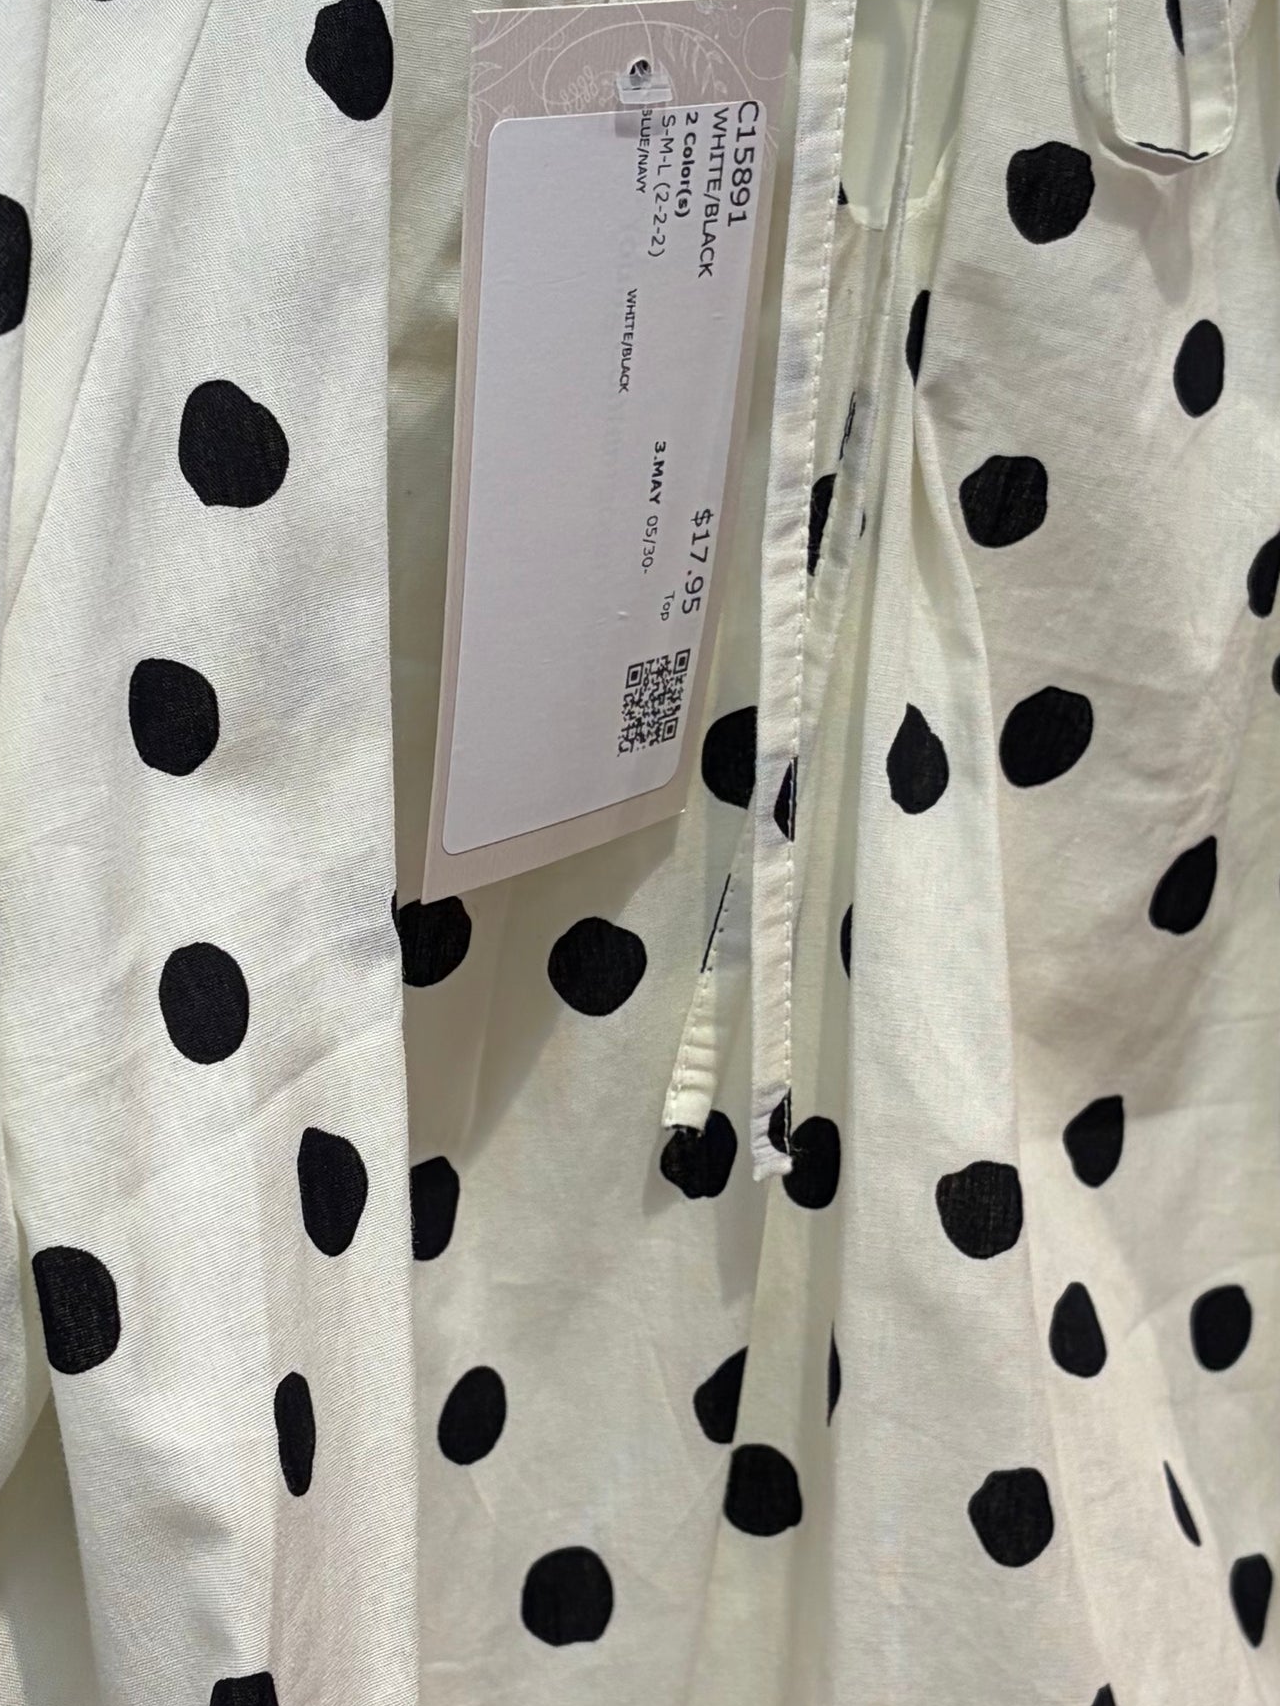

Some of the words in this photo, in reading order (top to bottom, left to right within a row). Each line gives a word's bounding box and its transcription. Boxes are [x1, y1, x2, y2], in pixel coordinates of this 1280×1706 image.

[636, 109, 653, 193] BLUE/NAVY
[657, 114, 676, 176] S-M-L
[685, 111, 699, 126] 2
[674, 132, 697, 218] Color(s)
[698, 107, 730, 278] WHITE/BLACK
[728, 100, 760, 227] C15891
[647, 182, 671, 257] (2-2-2)
[618, 288, 638, 394] WHITE/BLACK
[648, 441, 667, 505] 3.MAY
[681, 508, 714, 615] $17.95
[660, 590, 676, 622] Top
